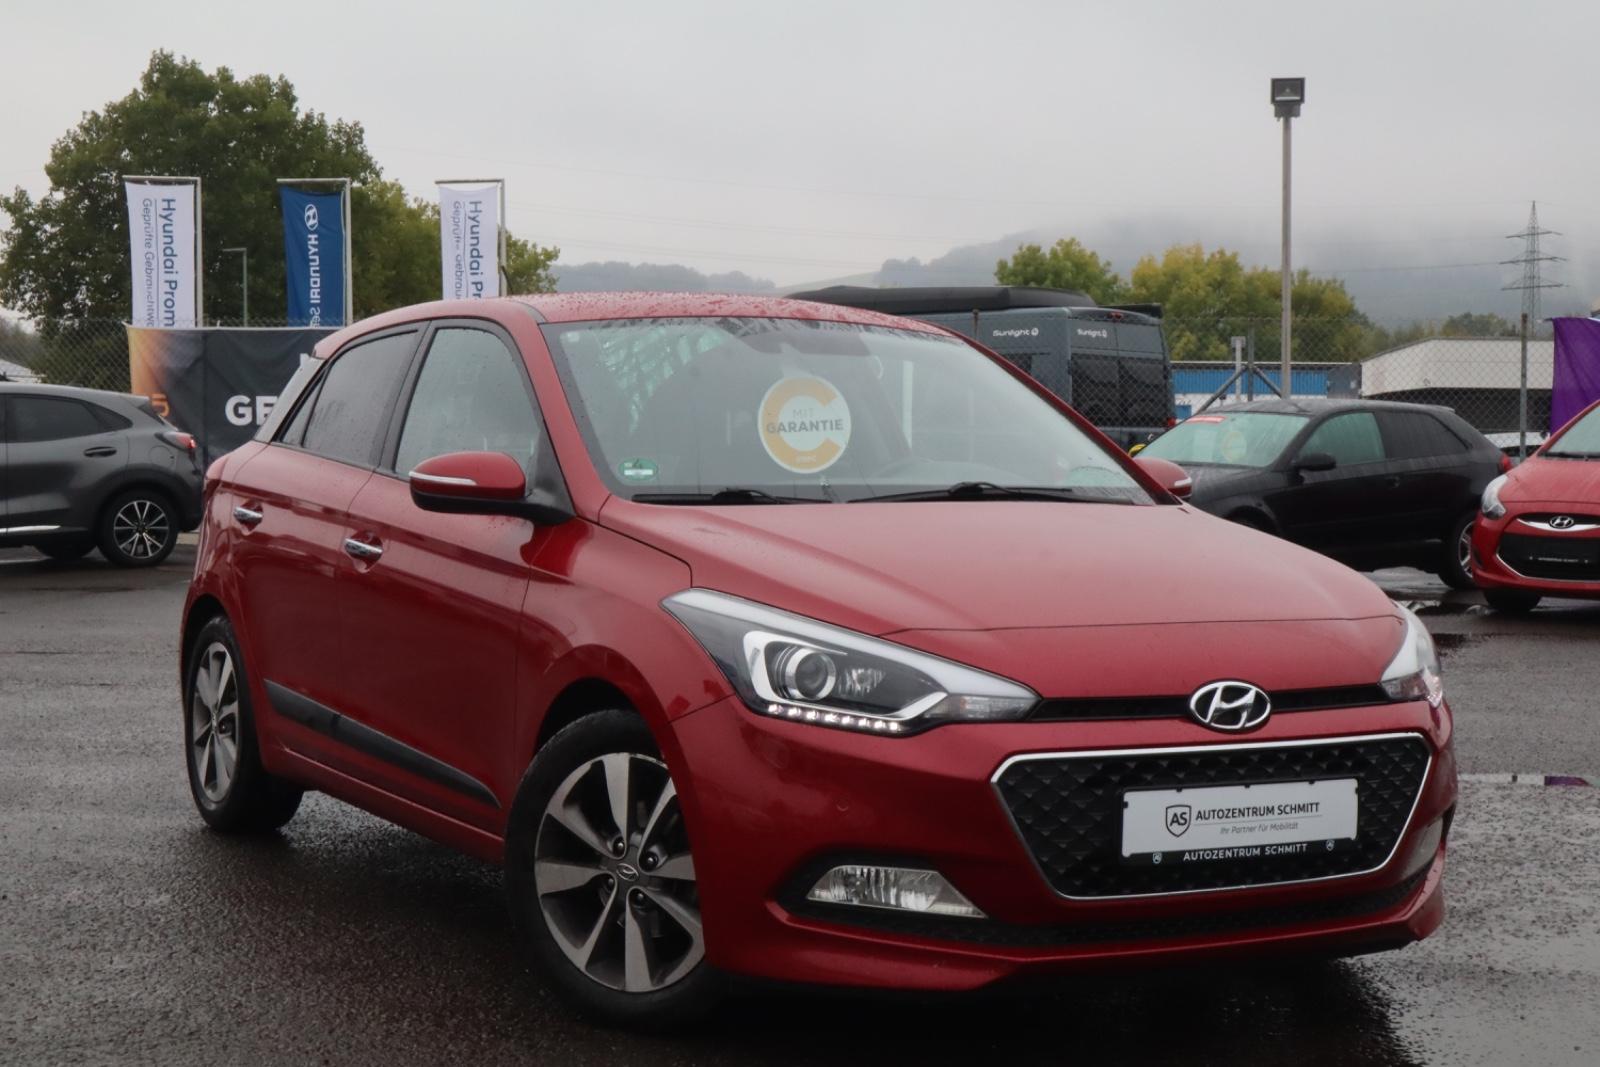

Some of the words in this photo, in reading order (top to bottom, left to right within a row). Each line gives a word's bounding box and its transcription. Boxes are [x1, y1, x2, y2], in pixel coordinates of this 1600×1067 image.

[142, 198, 155, 249] Geprüfte
[159, 198, 178, 274] Hyundai
[467, 201, 484, 276] Hyundai
[471, 281, 484, 299] Pr
[766, 419, 844, 433] GARANTIE
[1169, 812, 1188, 827] AS
[1195, 805, 1275, 821] AUTOZENTRUM
[1277, 802, 1320, 816] SCHMITT
[1231, 825, 1257, 834] Partner
[1258, 823, 1269, 833] für
[1270, 821, 1299, 831] Mobilität
[1183, 847, 1261, 861] AUTOZENTRUM
[1265, 843, 1308, 855] SCHMITT
